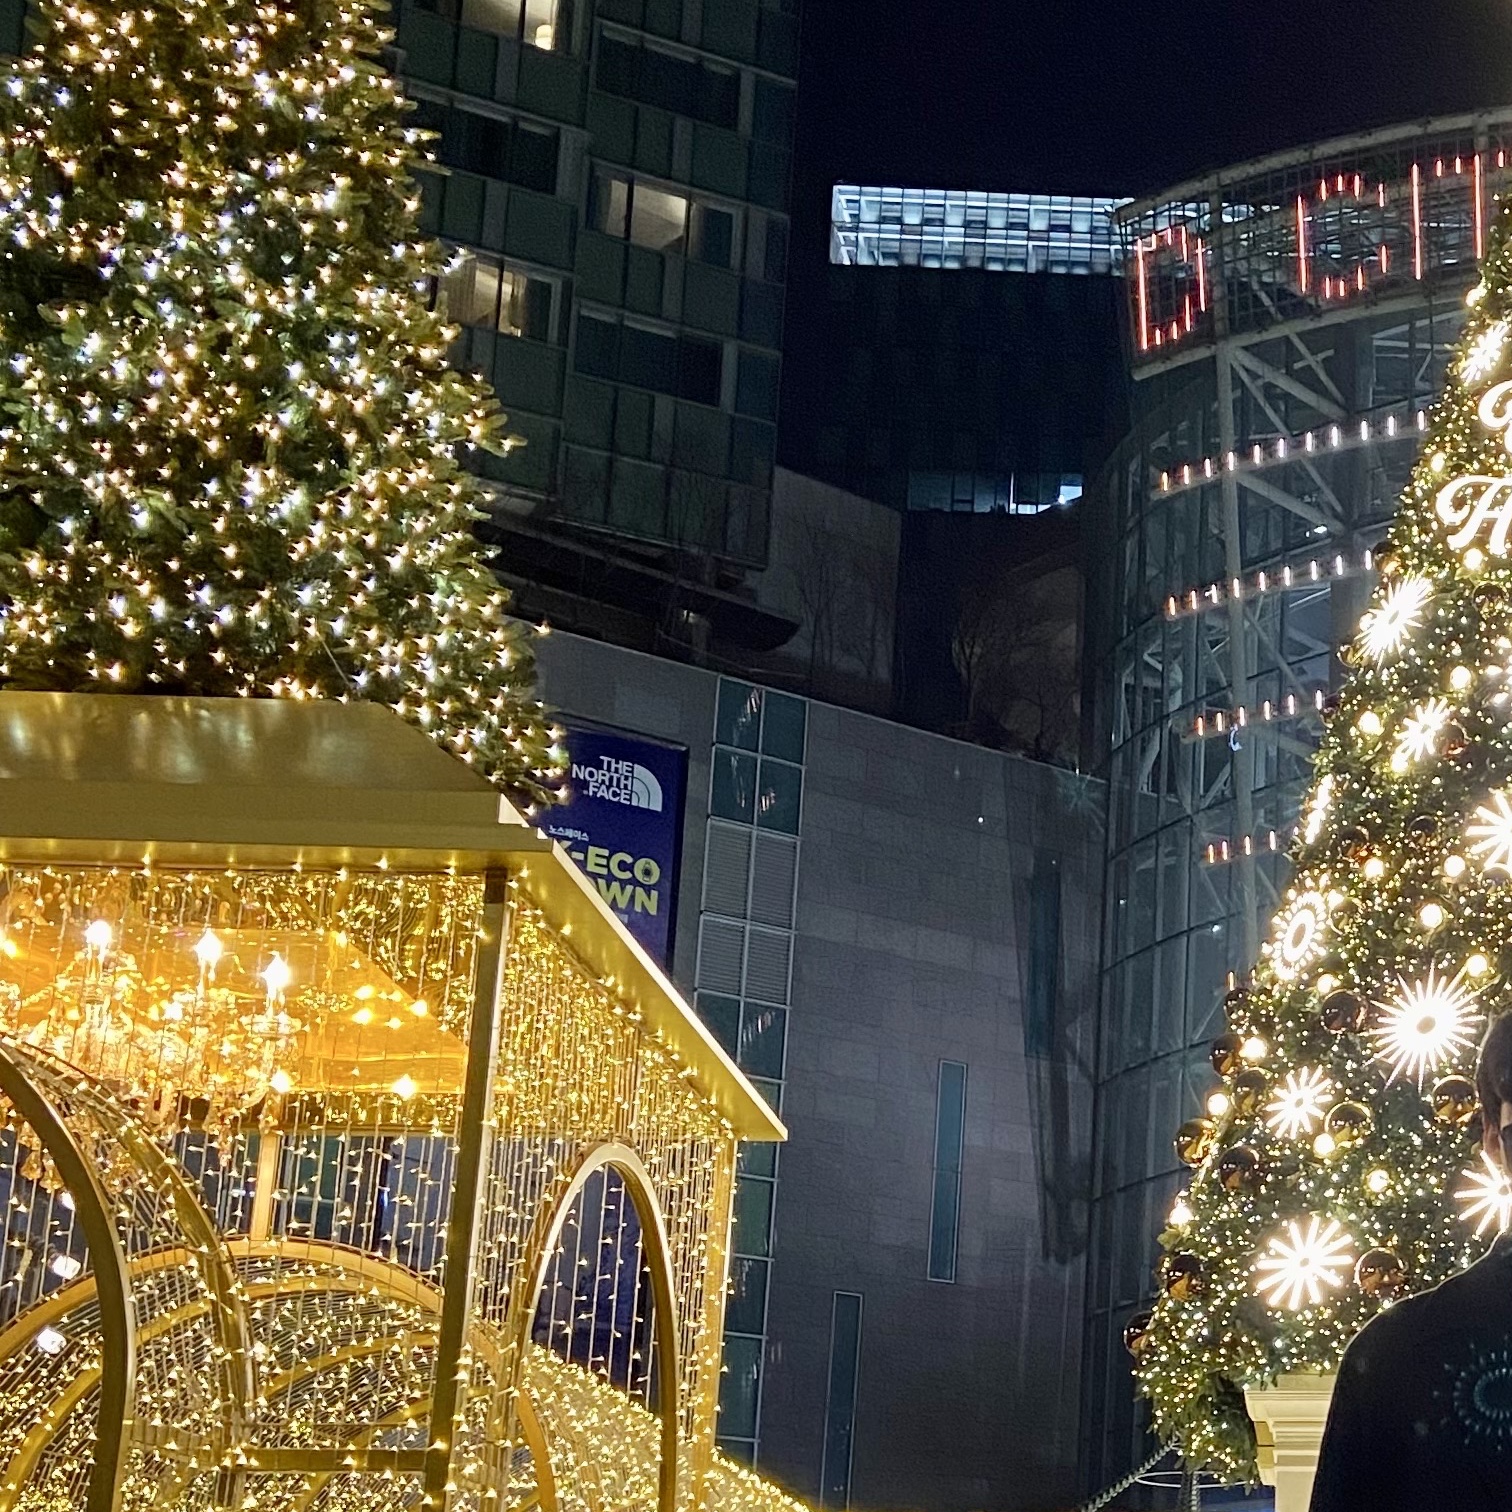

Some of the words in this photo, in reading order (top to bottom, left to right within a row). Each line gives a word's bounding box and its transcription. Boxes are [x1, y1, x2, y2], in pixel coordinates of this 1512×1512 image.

[572, 763, 632, 790] NORTH
[600, 756, 633, 776] THE
[589, 782, 632, 805] FACE
[585, 873, 659, 916] WN
